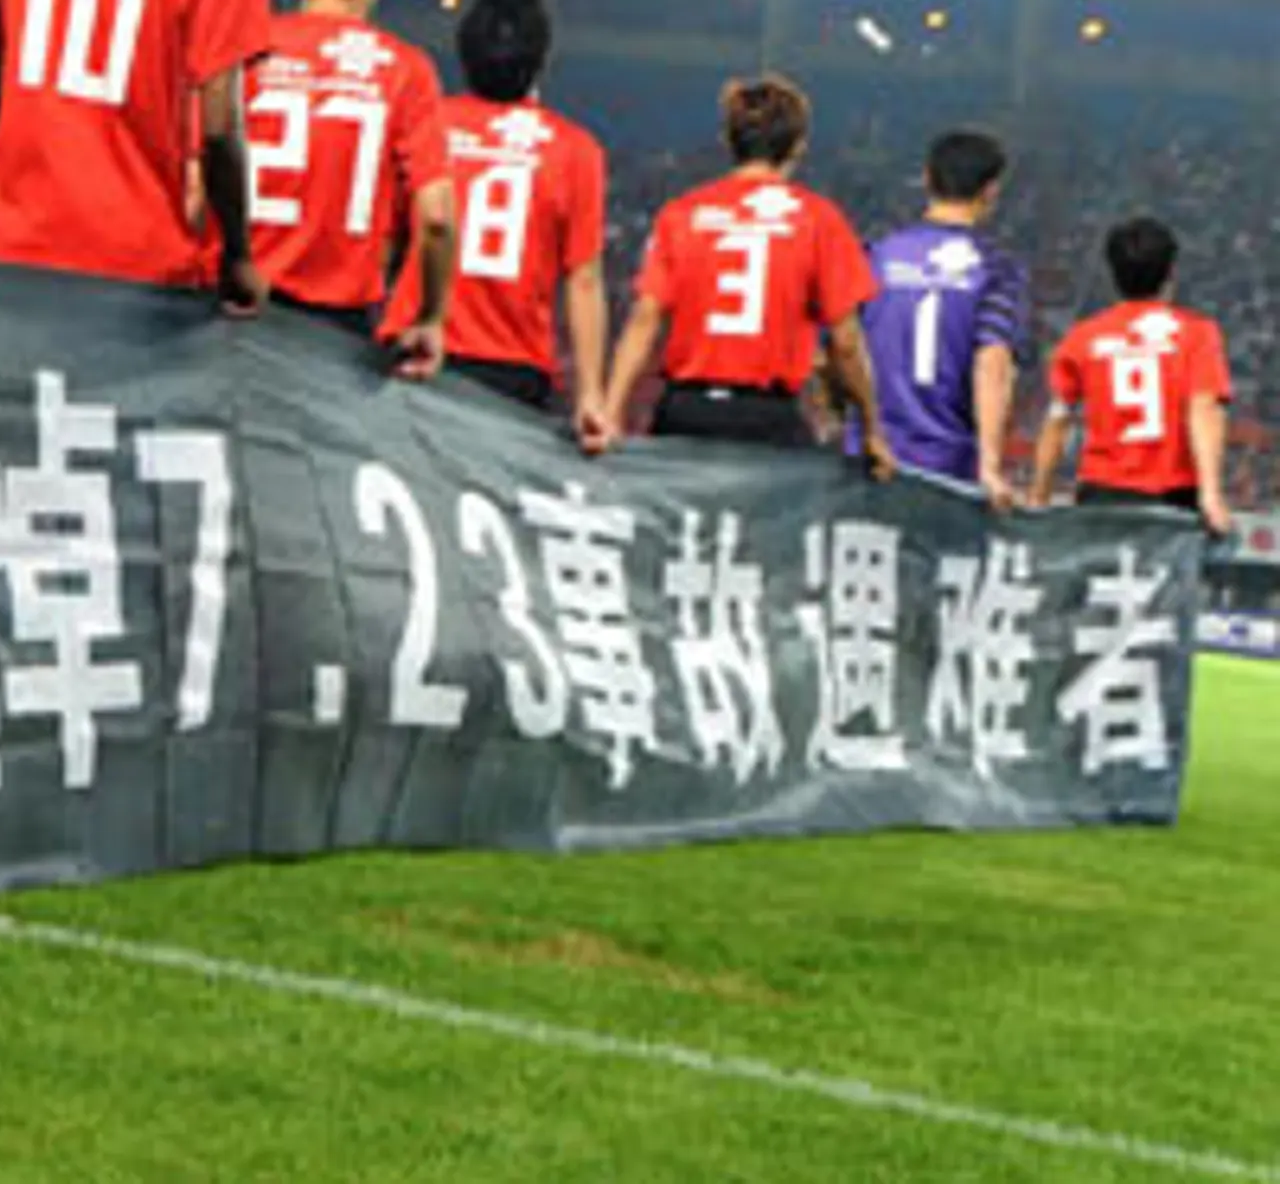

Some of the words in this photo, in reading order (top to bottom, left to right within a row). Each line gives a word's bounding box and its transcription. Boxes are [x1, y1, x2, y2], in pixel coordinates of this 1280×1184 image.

[244, 89, 388, 235] 27
[460, 159, 533, 280] 8
[704, 231, 769, 335] 3
[912, 289, 938, 385] 1
[1111, 352, 1165, 443] 9
